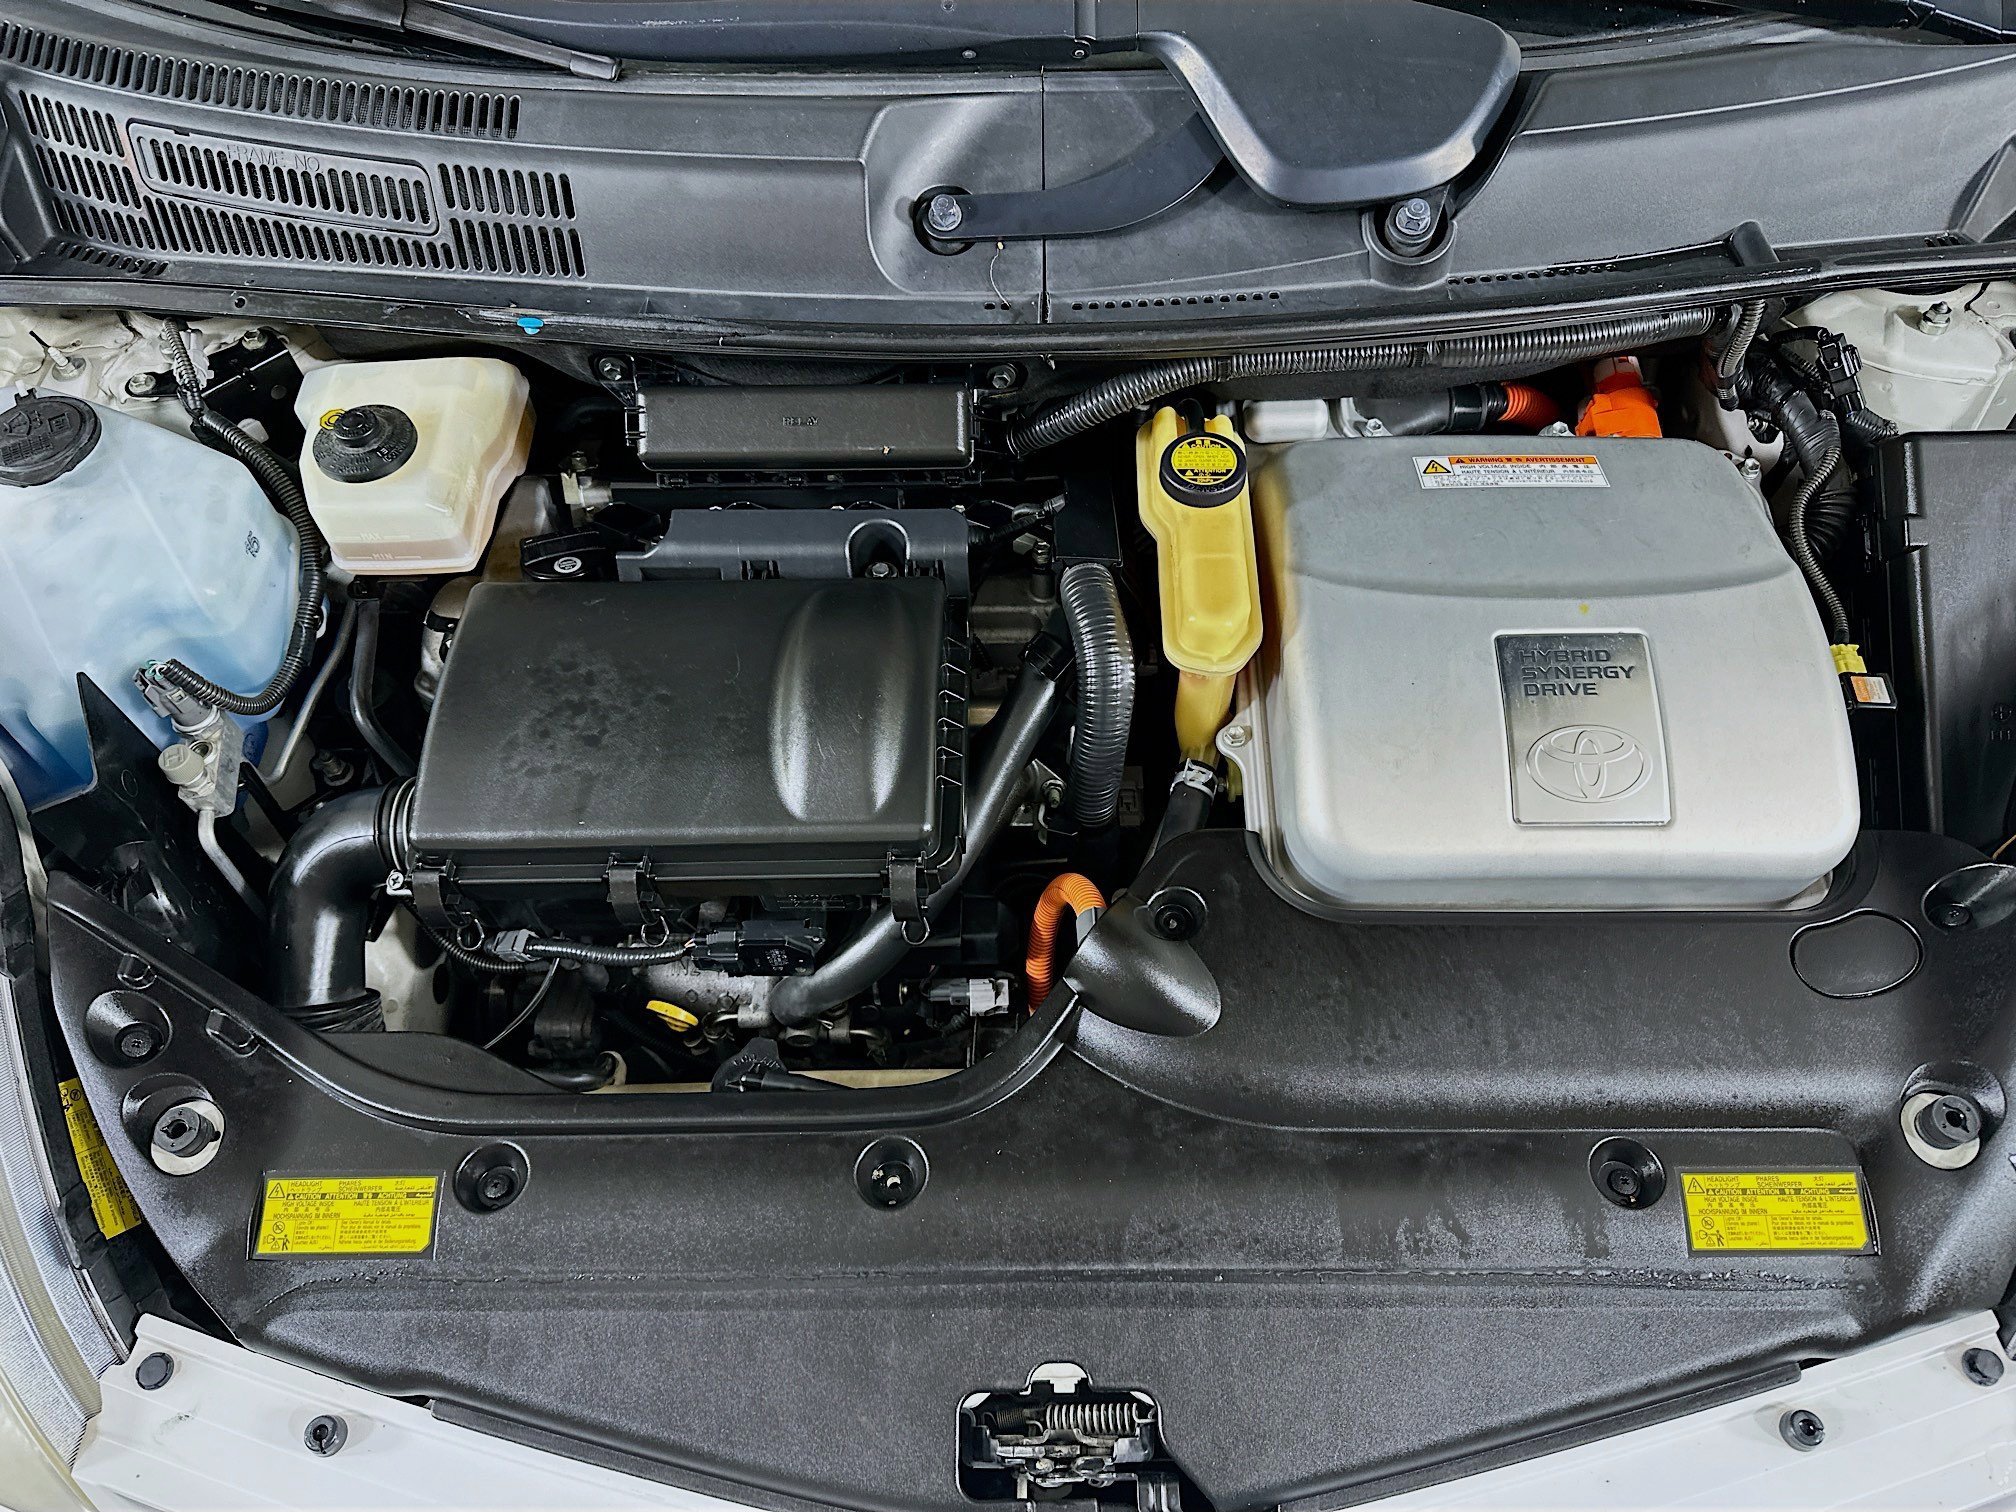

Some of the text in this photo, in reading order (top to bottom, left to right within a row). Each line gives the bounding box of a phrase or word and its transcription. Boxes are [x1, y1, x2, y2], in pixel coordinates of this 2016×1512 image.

[226, 144, 324, 174] FRAME NO.
[782, 416, 818, 426] RELAY
[359, 530, 382, 541] MAX
[371, 552, 395, 561] MIN
[1518, 649, 1612, 663] HYBRID
[1521, 665, 1636, 680] SYNERGY
[1523, 682, 1599, 697] DRIVE
[162, 746, 186, 767] H
